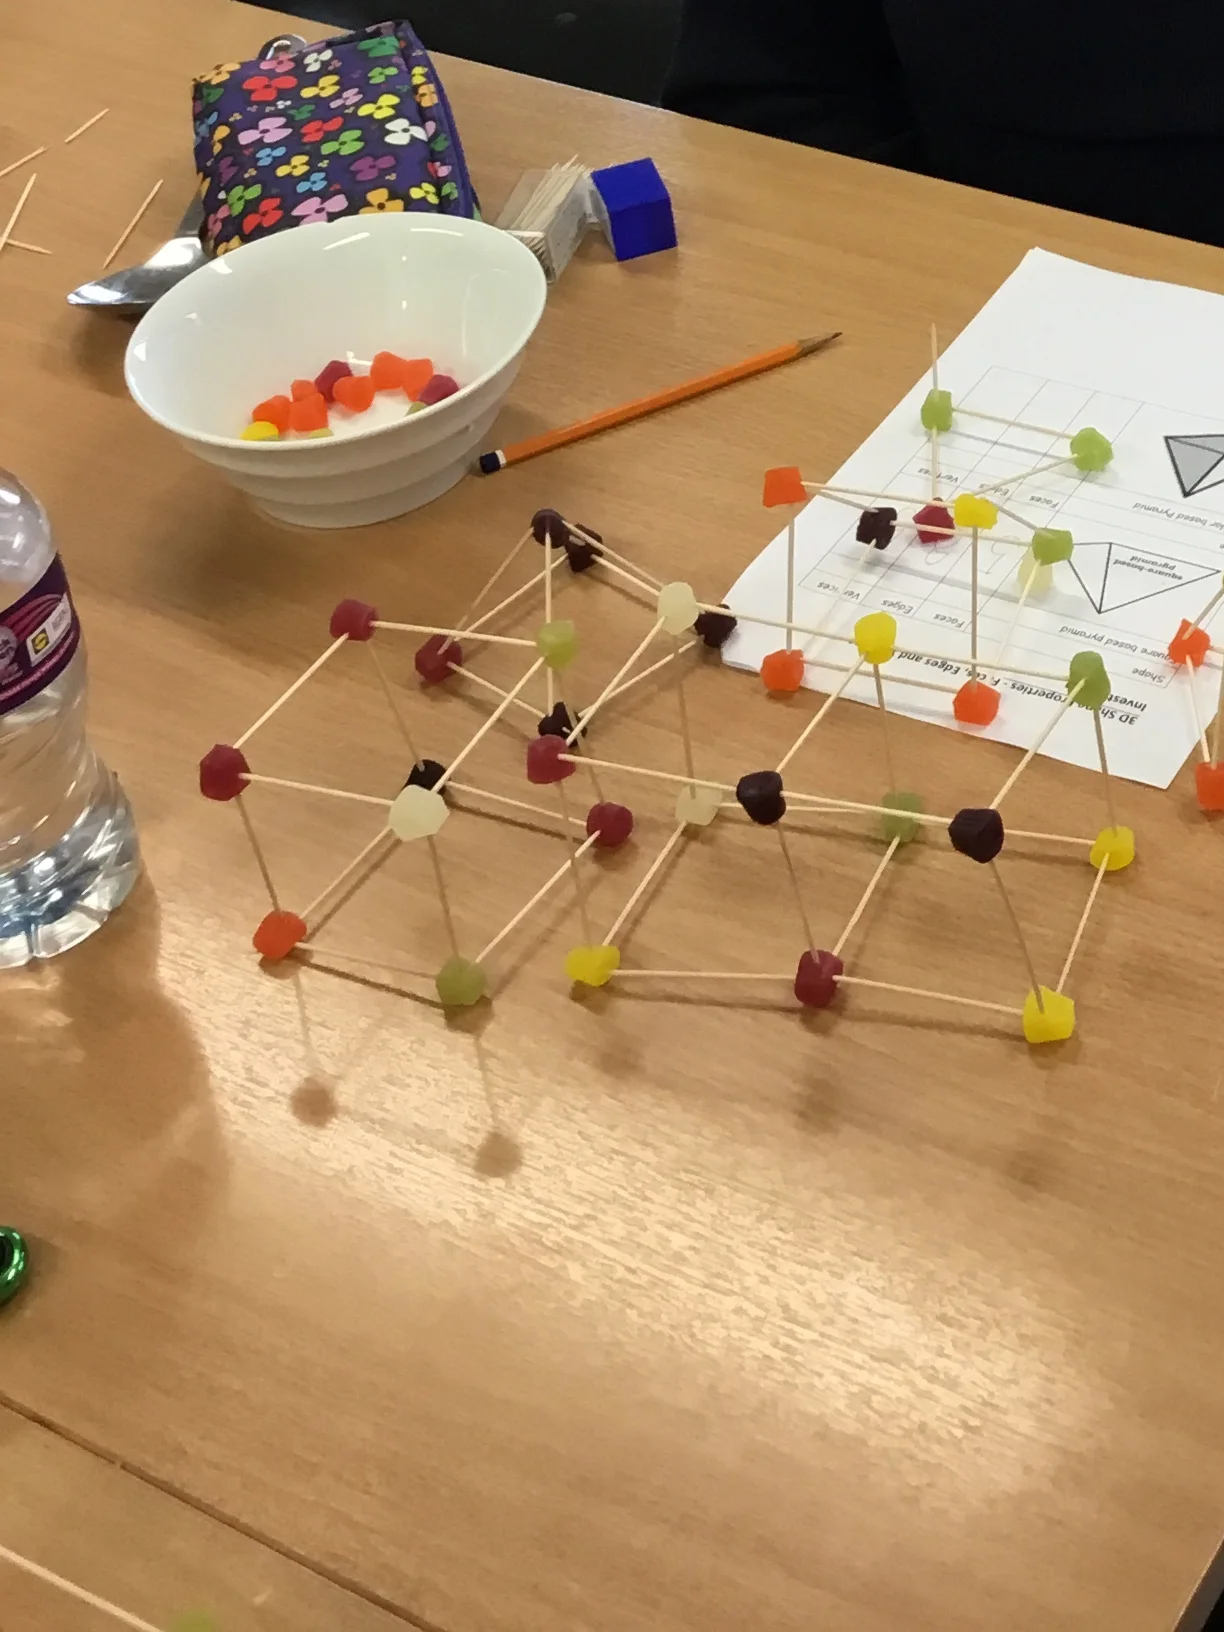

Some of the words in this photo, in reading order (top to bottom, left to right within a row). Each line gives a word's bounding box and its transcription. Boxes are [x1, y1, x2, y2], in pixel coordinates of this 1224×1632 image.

[917, 467, 959, 484] Vertes
[979, 483, 1010, 497] Eds
[1028, 495, 1060, 509] Faces
[1132, 502, 1175, 519] Pyramid
[1175, 512, 1208, 526] based
[1113, 558, 1183, 581] square-based
[1130, 555, 1177, 570] pyramid
[817, 581, 861, 600] Verices
[881, 599, 914, 614] Edges
[933, 613, 966, 629] Faces
[1059, 625, 1104, 642] pyramid
[1105, 637, 1139, 653] based
[897, 650, 924, 664] and
[924, 657, 961, 676] Edges
[964, 667, 1001, 686] Fces,
[1132, 667, 1167, 683] Shape
[1118, 713, 1138, 726] 3D
